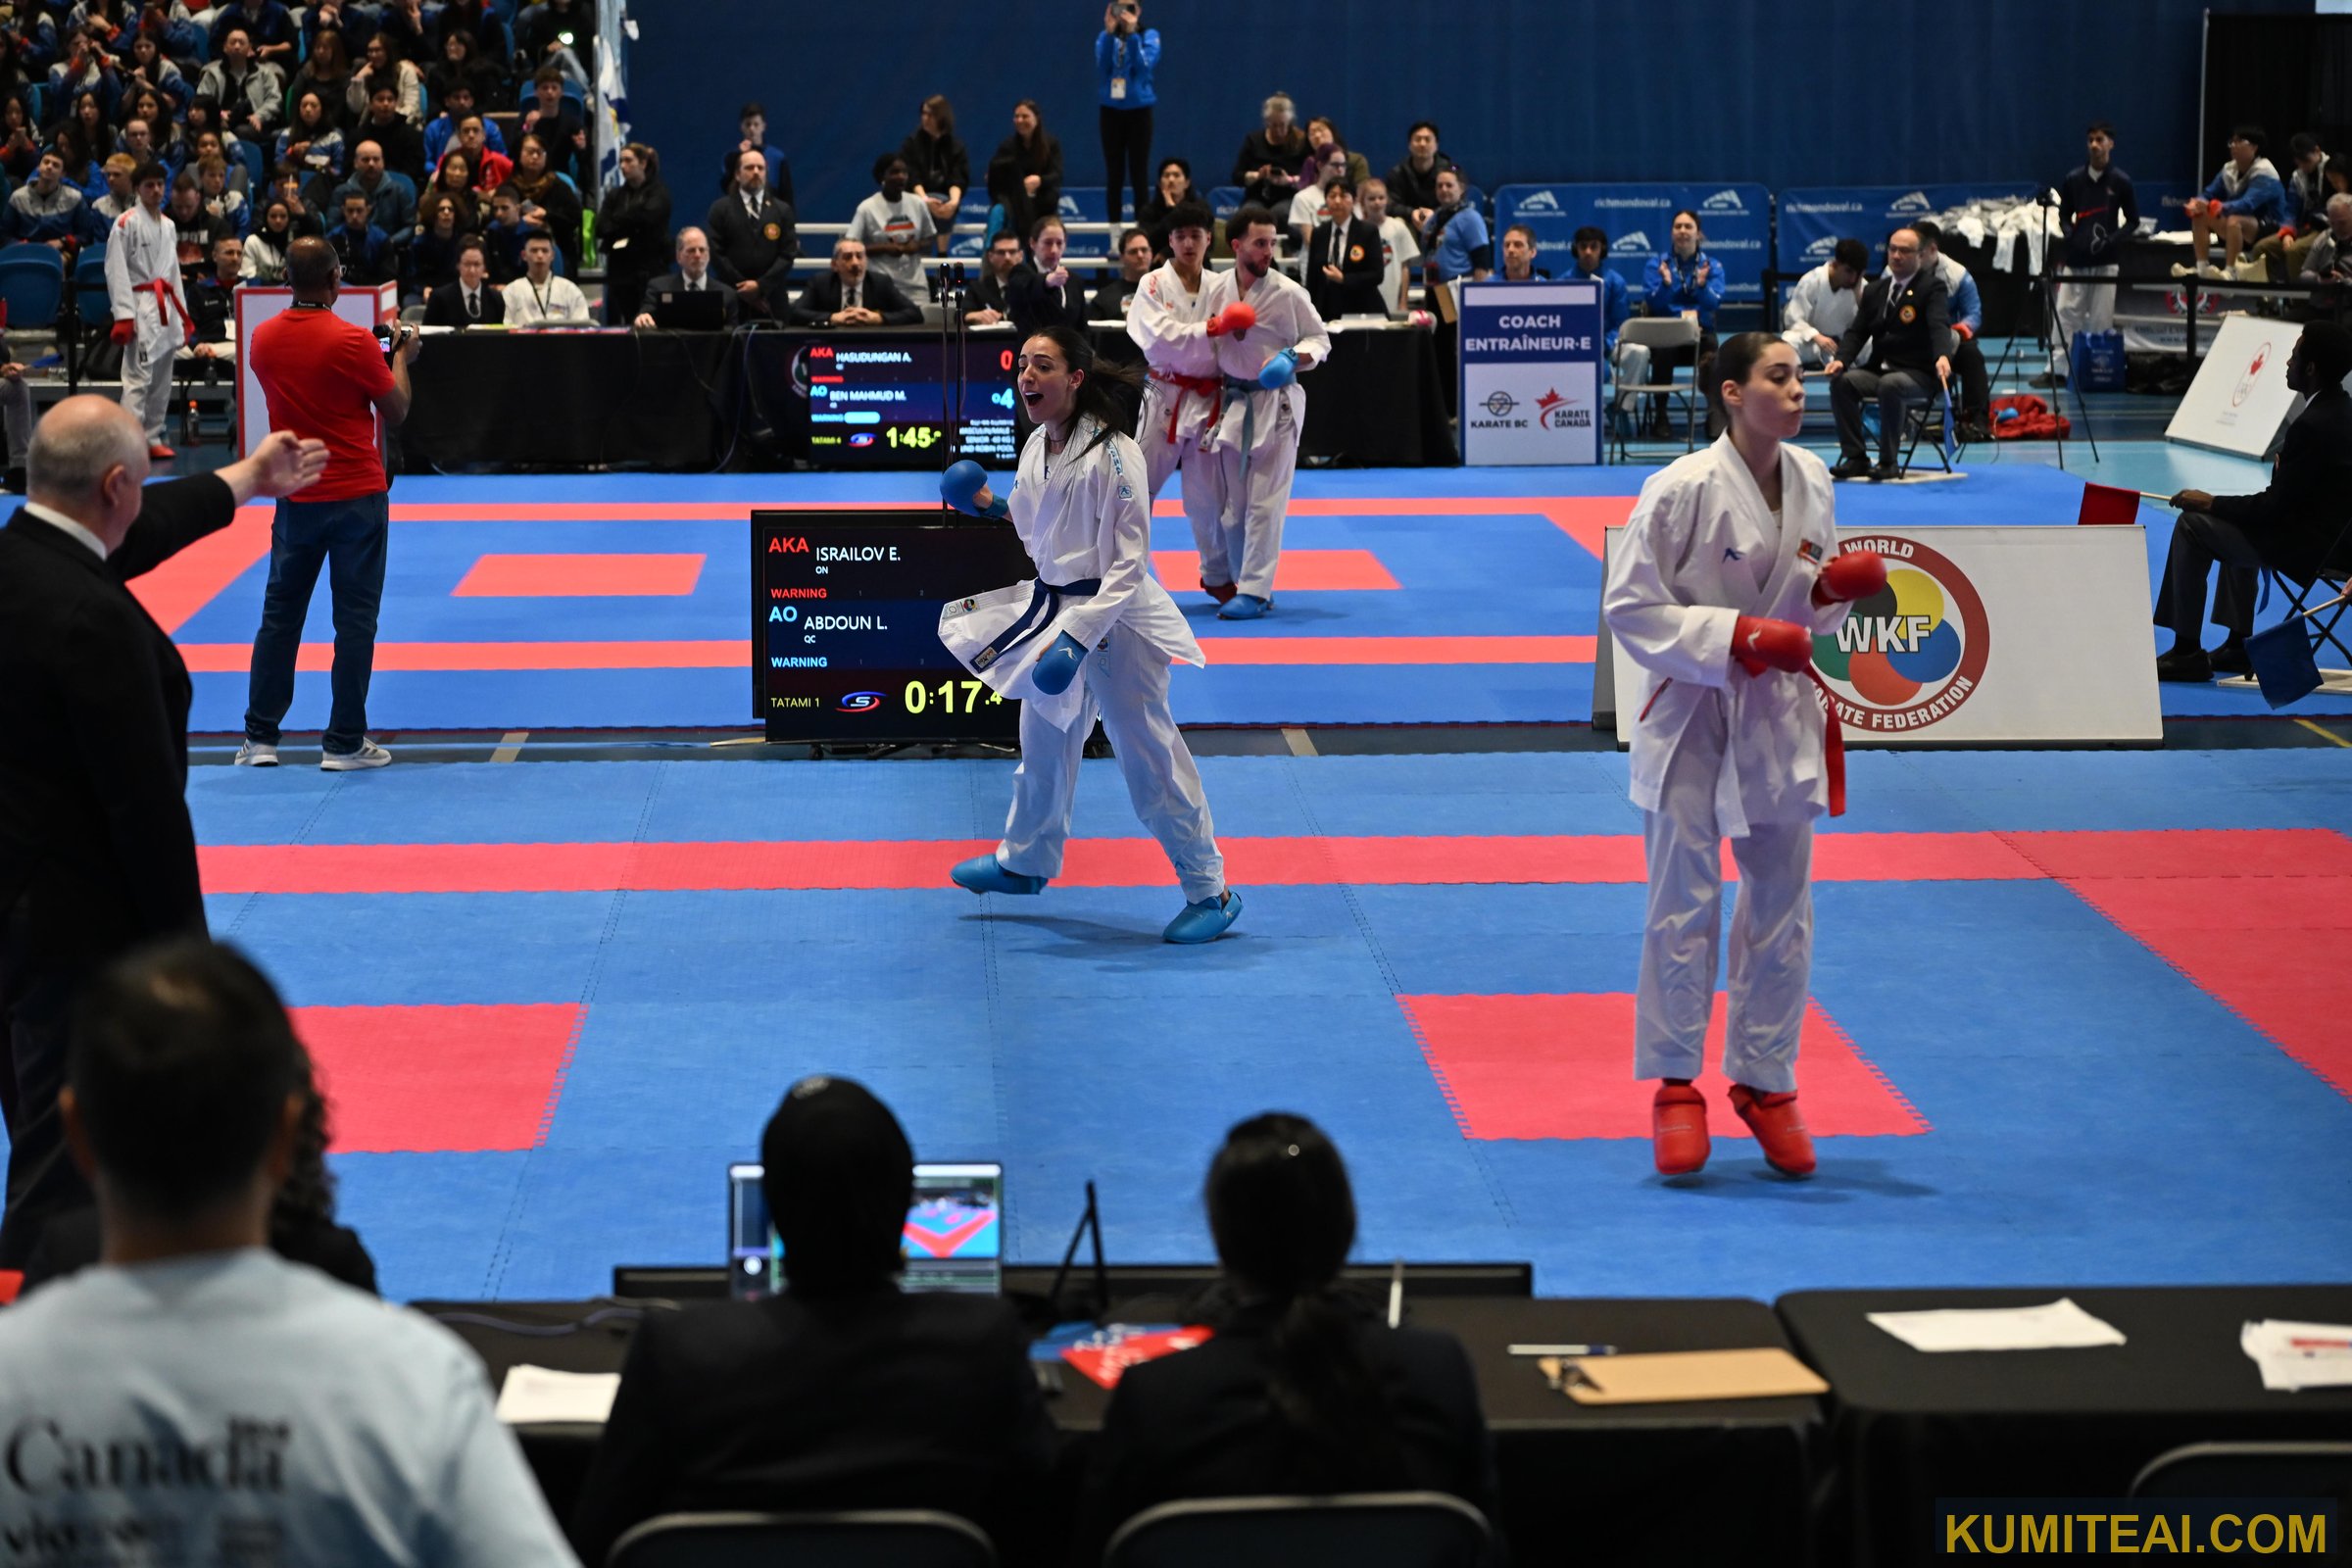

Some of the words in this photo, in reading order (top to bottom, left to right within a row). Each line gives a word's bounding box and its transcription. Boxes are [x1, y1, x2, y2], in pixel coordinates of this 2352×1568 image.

[1594, 197, 1672, 209] richmondoval.ca
[1786, 201, 1863, 214] richmondoval.ca
[1498, 315, 1561, 328] COACH
[809, 347, 833, 359] AKA
[836, 352, 901, 364] HASUDUNGAN
[1000, 350, 1013, 370] 0
[809, 385, 827, 397] AO
[829, 390, 849, 402] BEN
[850, 390, 895, 402] MAHMUD
[1554, 410, 1591, 418] KARATE
[1471, 419, 1511, 428] KARATE
[1554, 418, 1592, 428] CANADA
[768, 537, 809, 553] AKA
[1844, 539, 1914, 559] WORLD
[815, 547, 884, 562] ISRAILOV
[889, 547, 901, 562] E.
[815, 565, 829, 574] ON
[770, 588, 827, 599] WARNING
[768, 606, 798, 622] AO
[804, 615, 871, 630] ABDOUN
[876, 615, 888, 630] L.
[1836, 615, 1932, 654] WKF
[771, 657, 827, 667] WARNING
[771, 697, 812, 708] TATAMI
[815, 697, 820, 708] 1
[1872, 675, 1974, 729] FEDERATION
